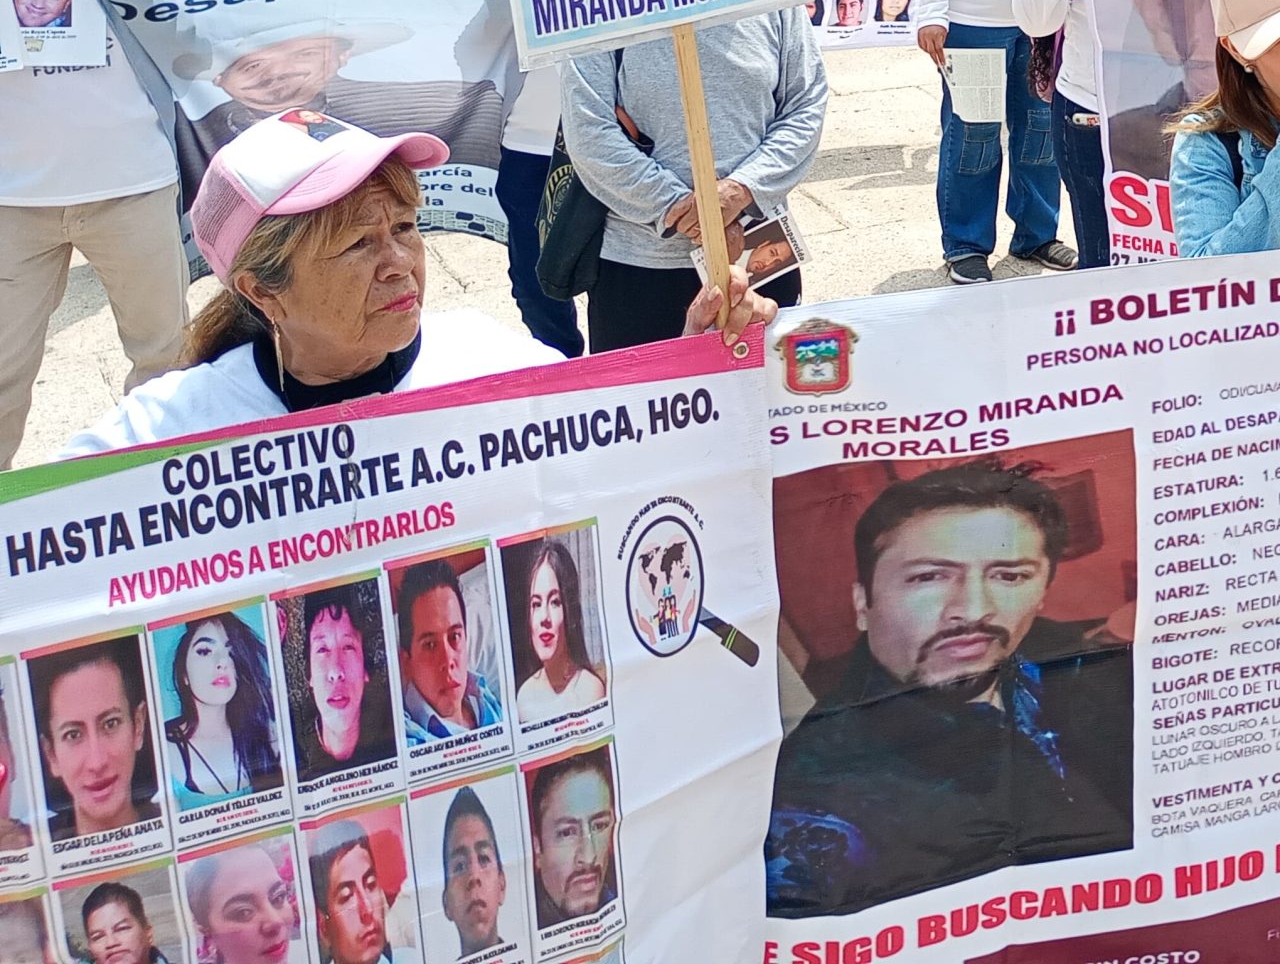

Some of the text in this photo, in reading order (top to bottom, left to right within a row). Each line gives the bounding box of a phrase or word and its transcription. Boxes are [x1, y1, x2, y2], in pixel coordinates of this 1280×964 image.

[1112, 233, 1164, 255] FECHA
[1090, 278, 1255, 325] BOLETÍN
[1027, 342, 1128, 370] PERSONA
[1133, 338, 1164, 356] NO
[801, 383, 1125, 440] LORENZO MIRANDA
[807, 400, 888, 415] DE MÉXICO
[1152, 394, 1203, 414] FOLIO:
[842, 428, 1010, 460] MORALES
[1152, 425, 1196, 444] EDAD
[1201, 418, 1221, 435] AL
[162, 423, 355, 495] COLECTIVO
[1153, 452, 1207, 471] FECHA
[1211, 446, 1233, 462] DE
[6, 387, 720, 577] HASTA ENCONTRARTE A.C. PACHUCA, HGO.
[1153, 496, 1265, 526] COMPLEXIÓN:
[109, 501, 456, 607] AYUDANOS A ENCONTRARLOS
[1152, 779, 1254, 809] VESTIMENTA
[792, 925, 904, 964] SIGO
[917, 873, 1164, 948] BUSCANDO
[1174, 850, 1265, 899] HIJO
